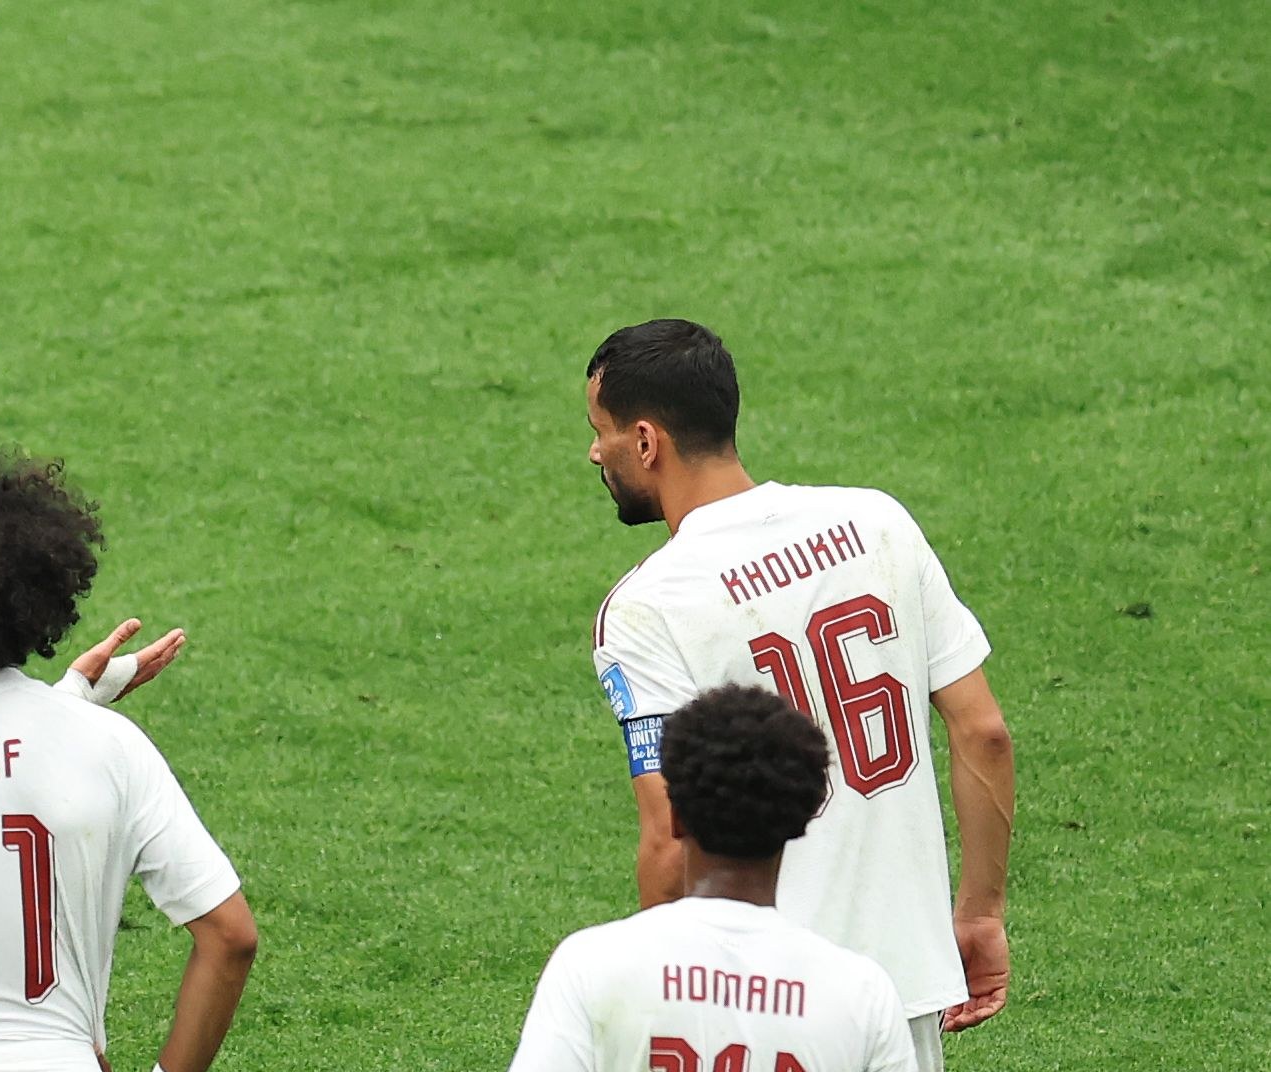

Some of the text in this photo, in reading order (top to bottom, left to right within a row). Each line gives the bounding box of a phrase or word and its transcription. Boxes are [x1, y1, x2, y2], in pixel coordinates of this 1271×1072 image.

[720, 519, 865, 605] KHOUKHI
[628, 717, 663, 732] FOOTBA
[748, 594, 919, 818] 16
[630, 728, 664, 747] UNIT
[662, 964, 806, 1017] HOMAM
